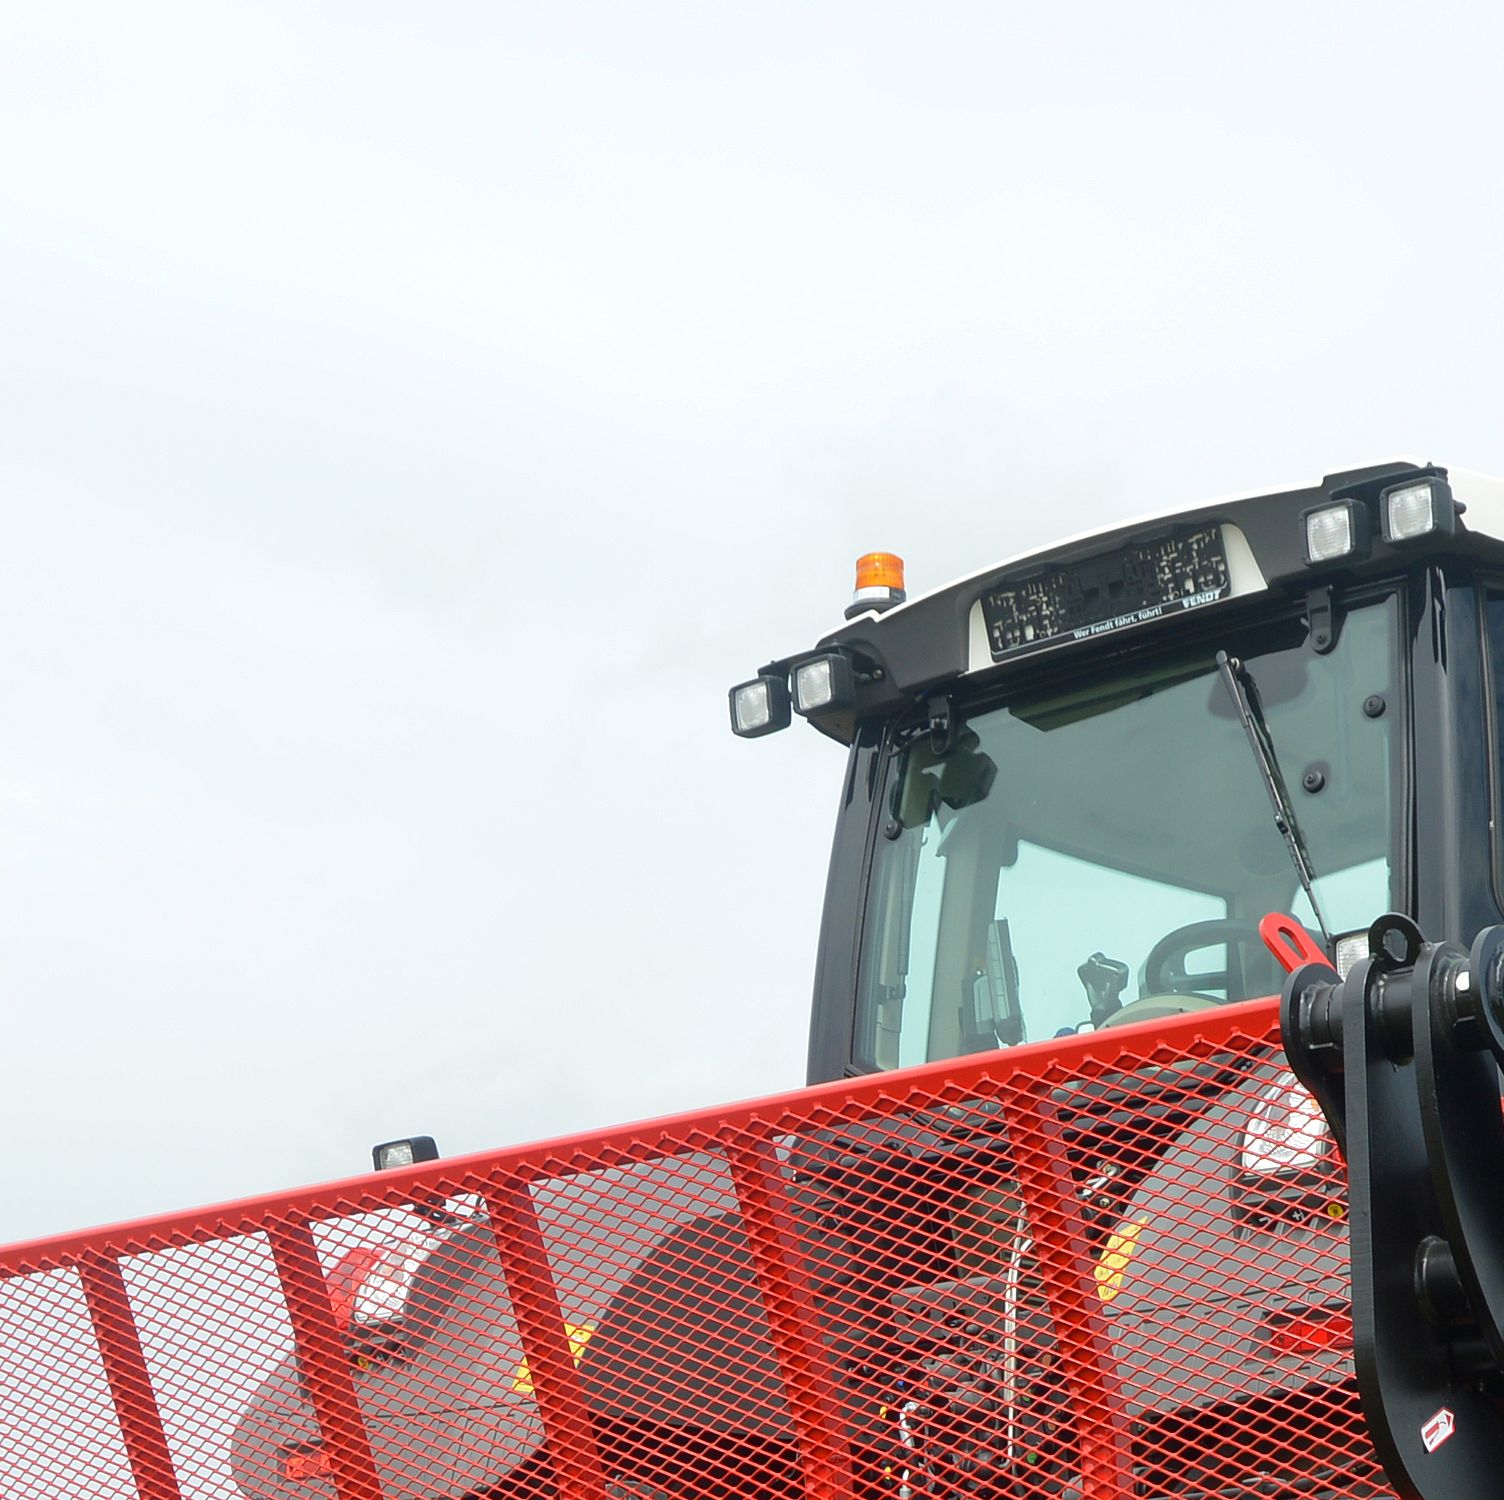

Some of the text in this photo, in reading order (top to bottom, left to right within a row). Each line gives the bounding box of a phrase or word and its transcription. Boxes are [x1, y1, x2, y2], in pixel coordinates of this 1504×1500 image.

[1182, 588, 1222, 609] FENDT
[1073, 606, 1163, 640] Wer Fendt fährt, führt!
